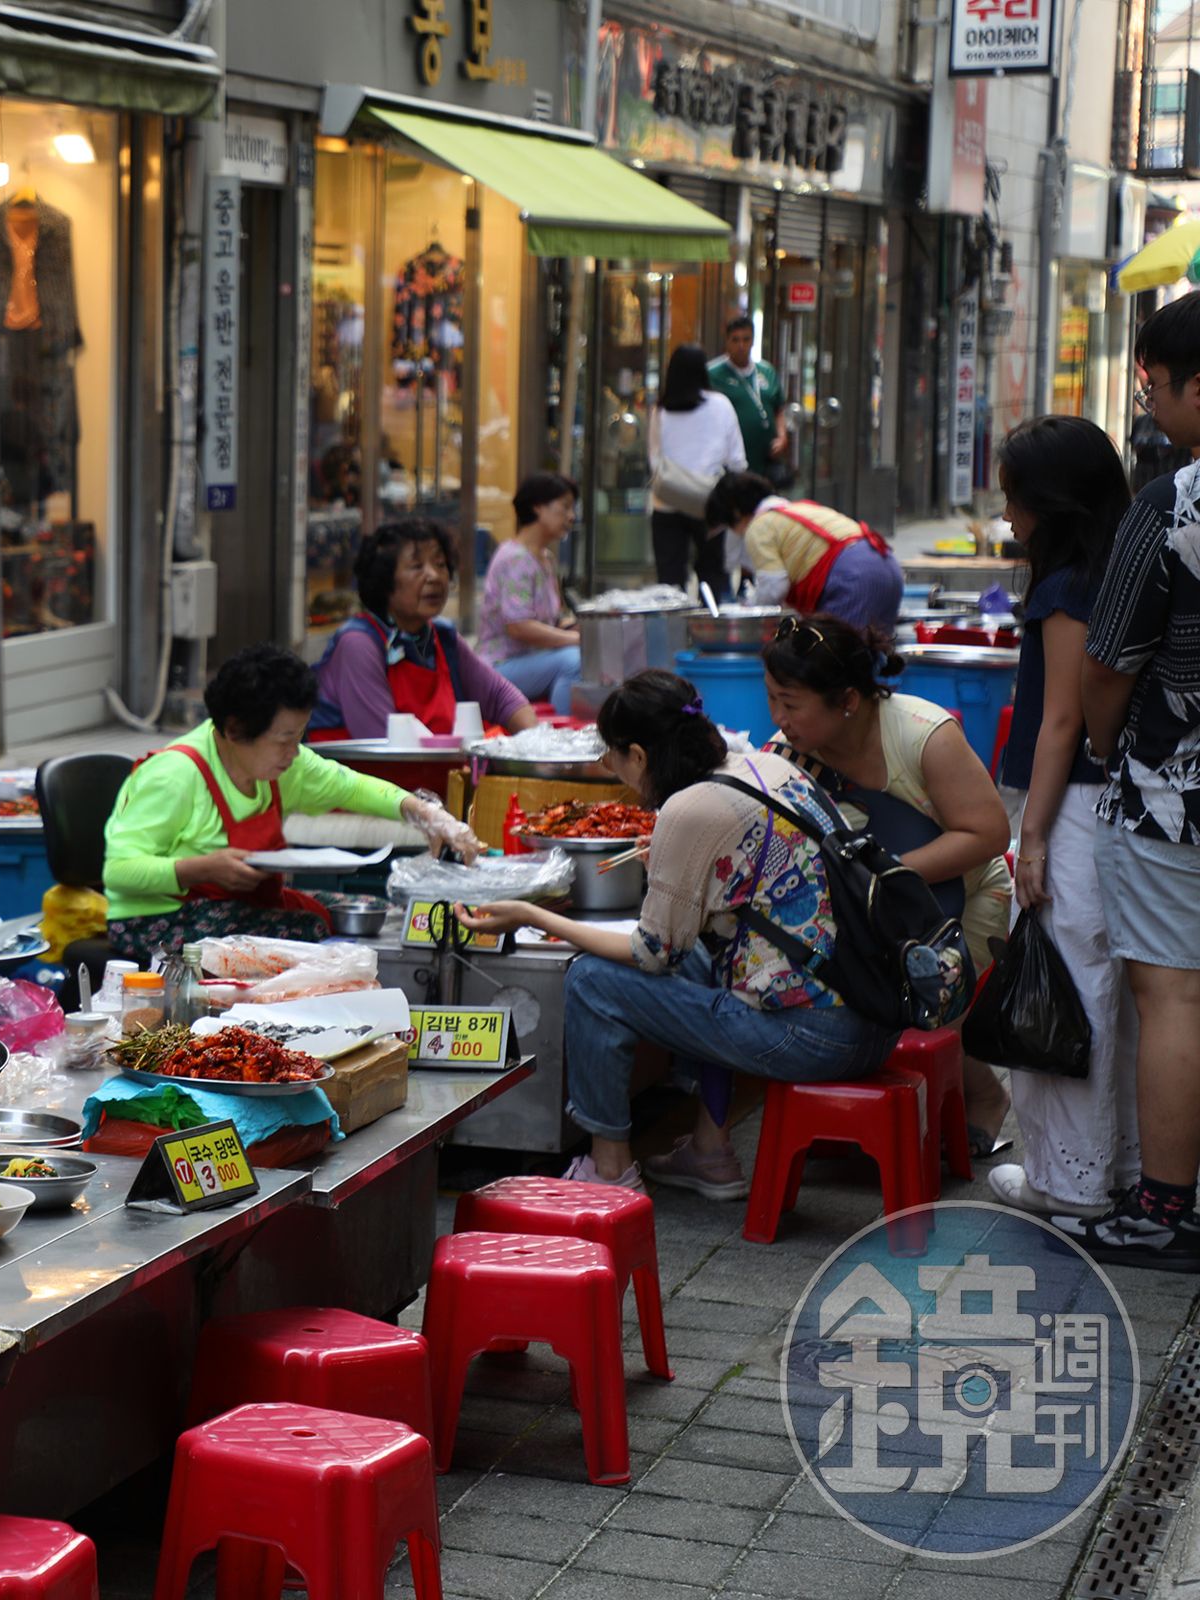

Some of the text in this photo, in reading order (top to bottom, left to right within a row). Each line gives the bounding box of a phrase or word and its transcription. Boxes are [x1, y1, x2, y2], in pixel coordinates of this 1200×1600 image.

[215, 189, 235, 258] 중고
[427, 1015, 498, 1032] 김밥 8개
[189, 1136, 239, 1162] 국수,당면
[175, 1160, 192, 1184] 17
